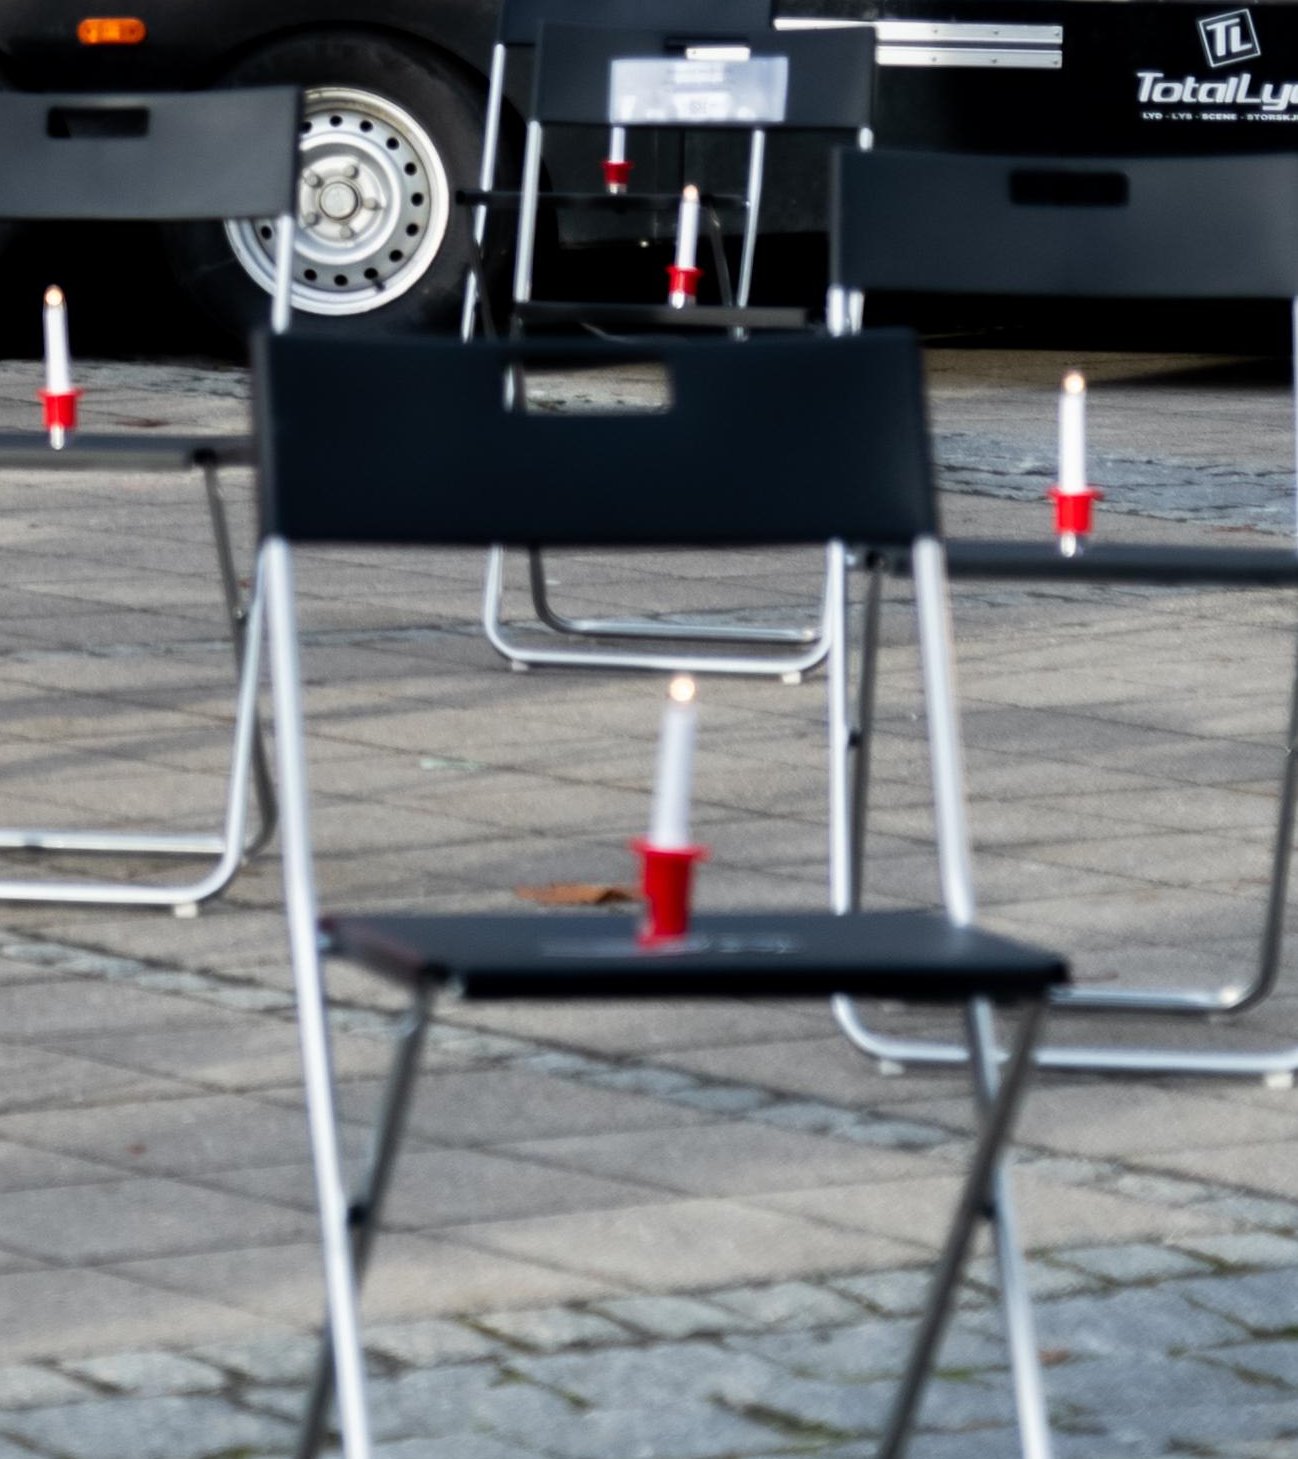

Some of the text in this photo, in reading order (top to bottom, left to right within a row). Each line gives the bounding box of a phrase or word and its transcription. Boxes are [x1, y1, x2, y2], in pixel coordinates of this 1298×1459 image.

[1206, 18, 1253, 57] TL
[1142, 112, 1163, 120] LYD
[1170, 112, 1193, 120] LYS
[1201, 112, 1237, 121] SCENE
